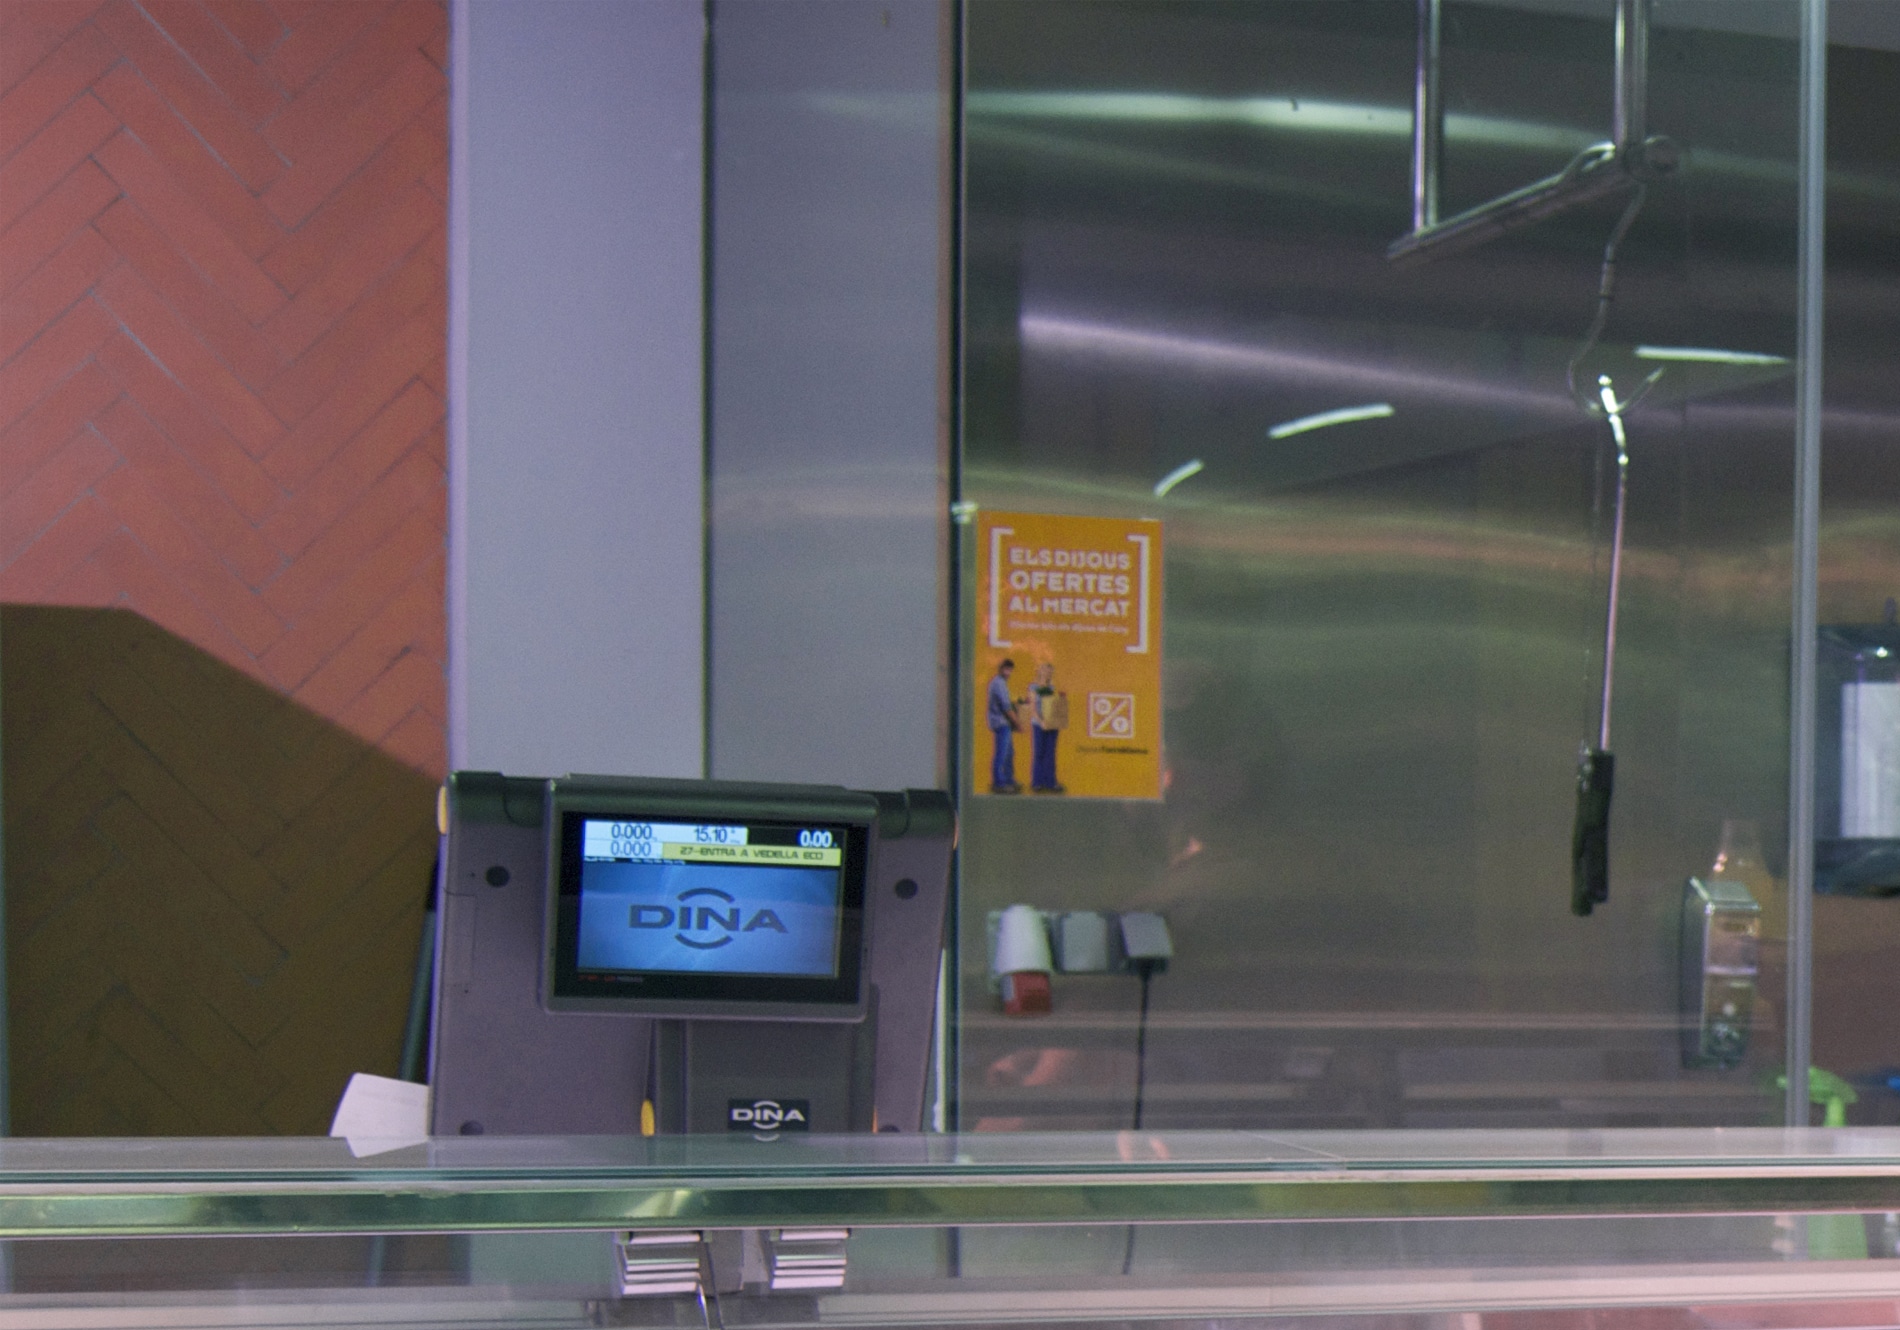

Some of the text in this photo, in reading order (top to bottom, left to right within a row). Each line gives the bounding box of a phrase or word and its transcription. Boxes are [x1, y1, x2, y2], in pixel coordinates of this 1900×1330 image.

[1008, 546, 1130, 570] ELS DIJOUS
[1008, 569, 1131, 596] OFERTES
[1008, 595, 1130, 617] AL MERCAT
[628, 903, 789, 934] DINA
[731, 1108, 806, 1122] DINA
